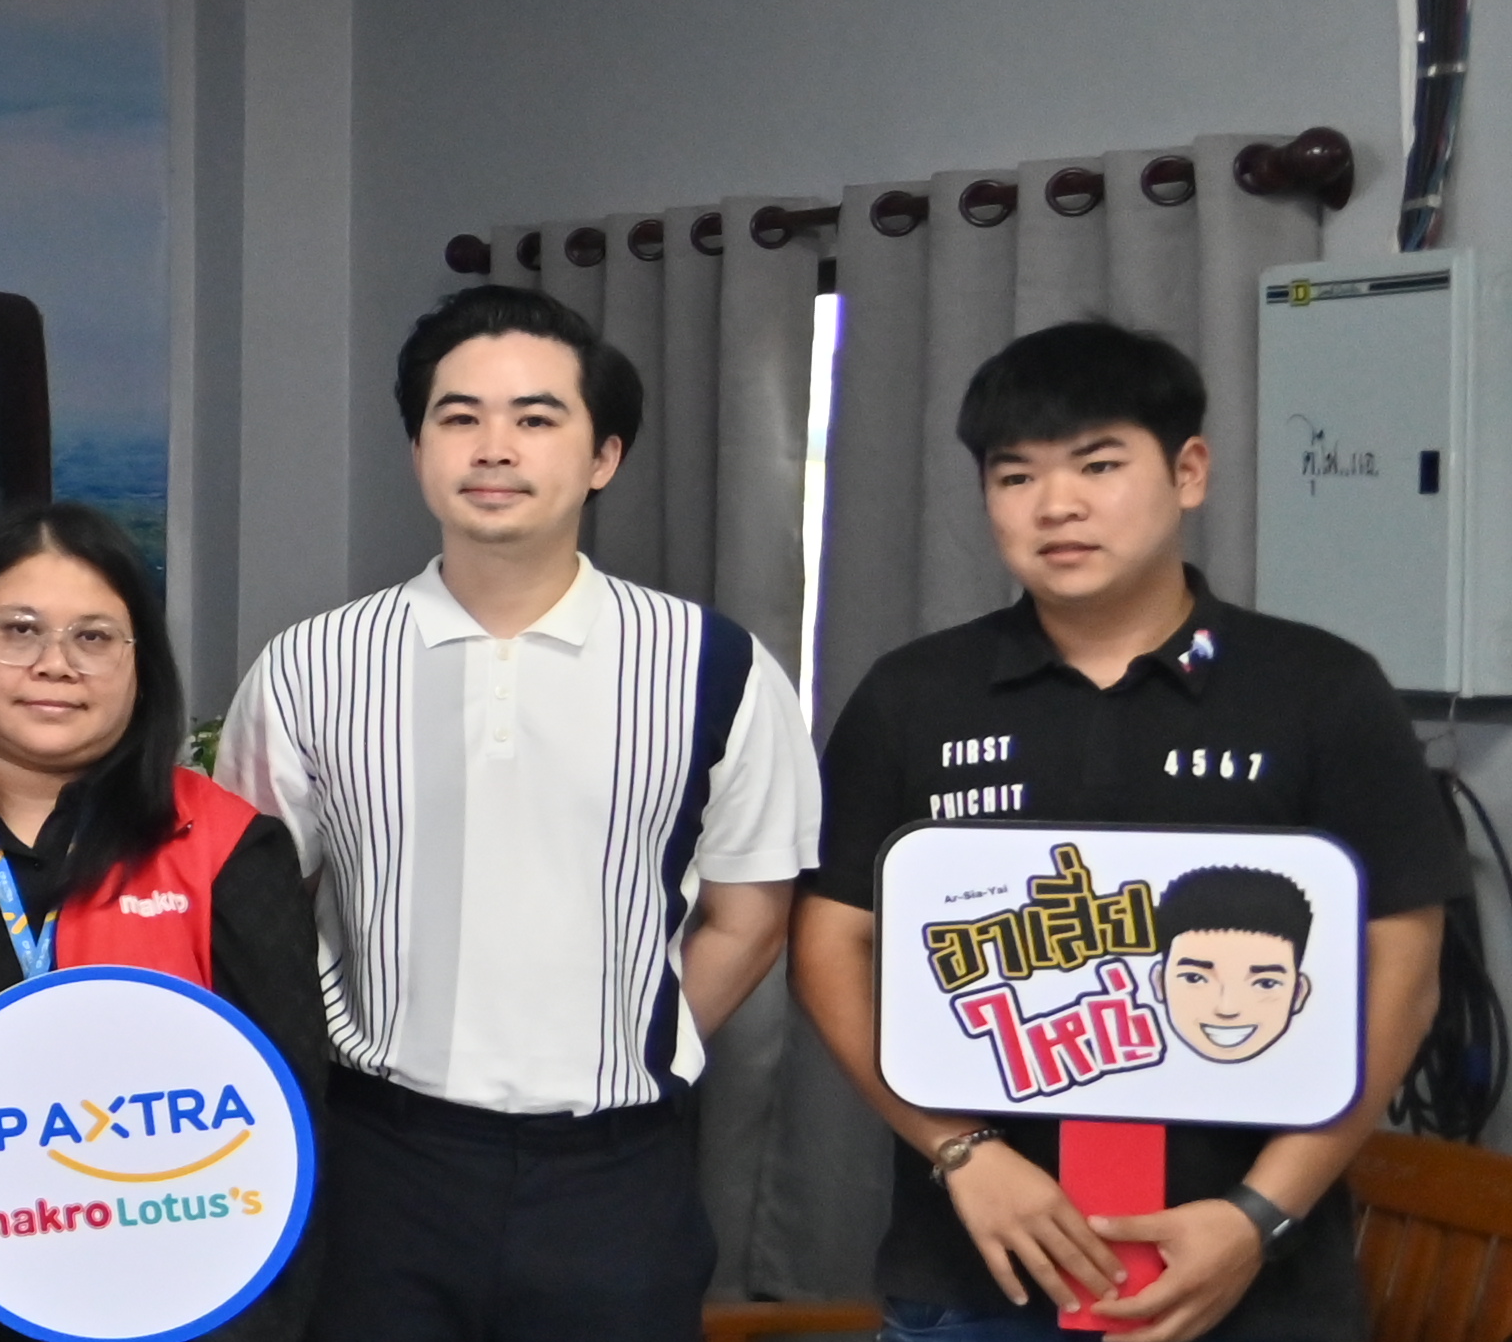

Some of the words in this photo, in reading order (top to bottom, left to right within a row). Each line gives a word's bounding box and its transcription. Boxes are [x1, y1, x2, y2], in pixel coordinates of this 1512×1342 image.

[941, 734, 1011, 768] FIRST
[929, 783, 1024, 821] PHICHIT
[944, 884, 1009, 904] Ar-Sia-Yai
[954, 962, 1165, 1101] ใหญ่
[38, 1083, 256, 1148] AXTRA
[117, 1185, 263, 1227] Lotus's
